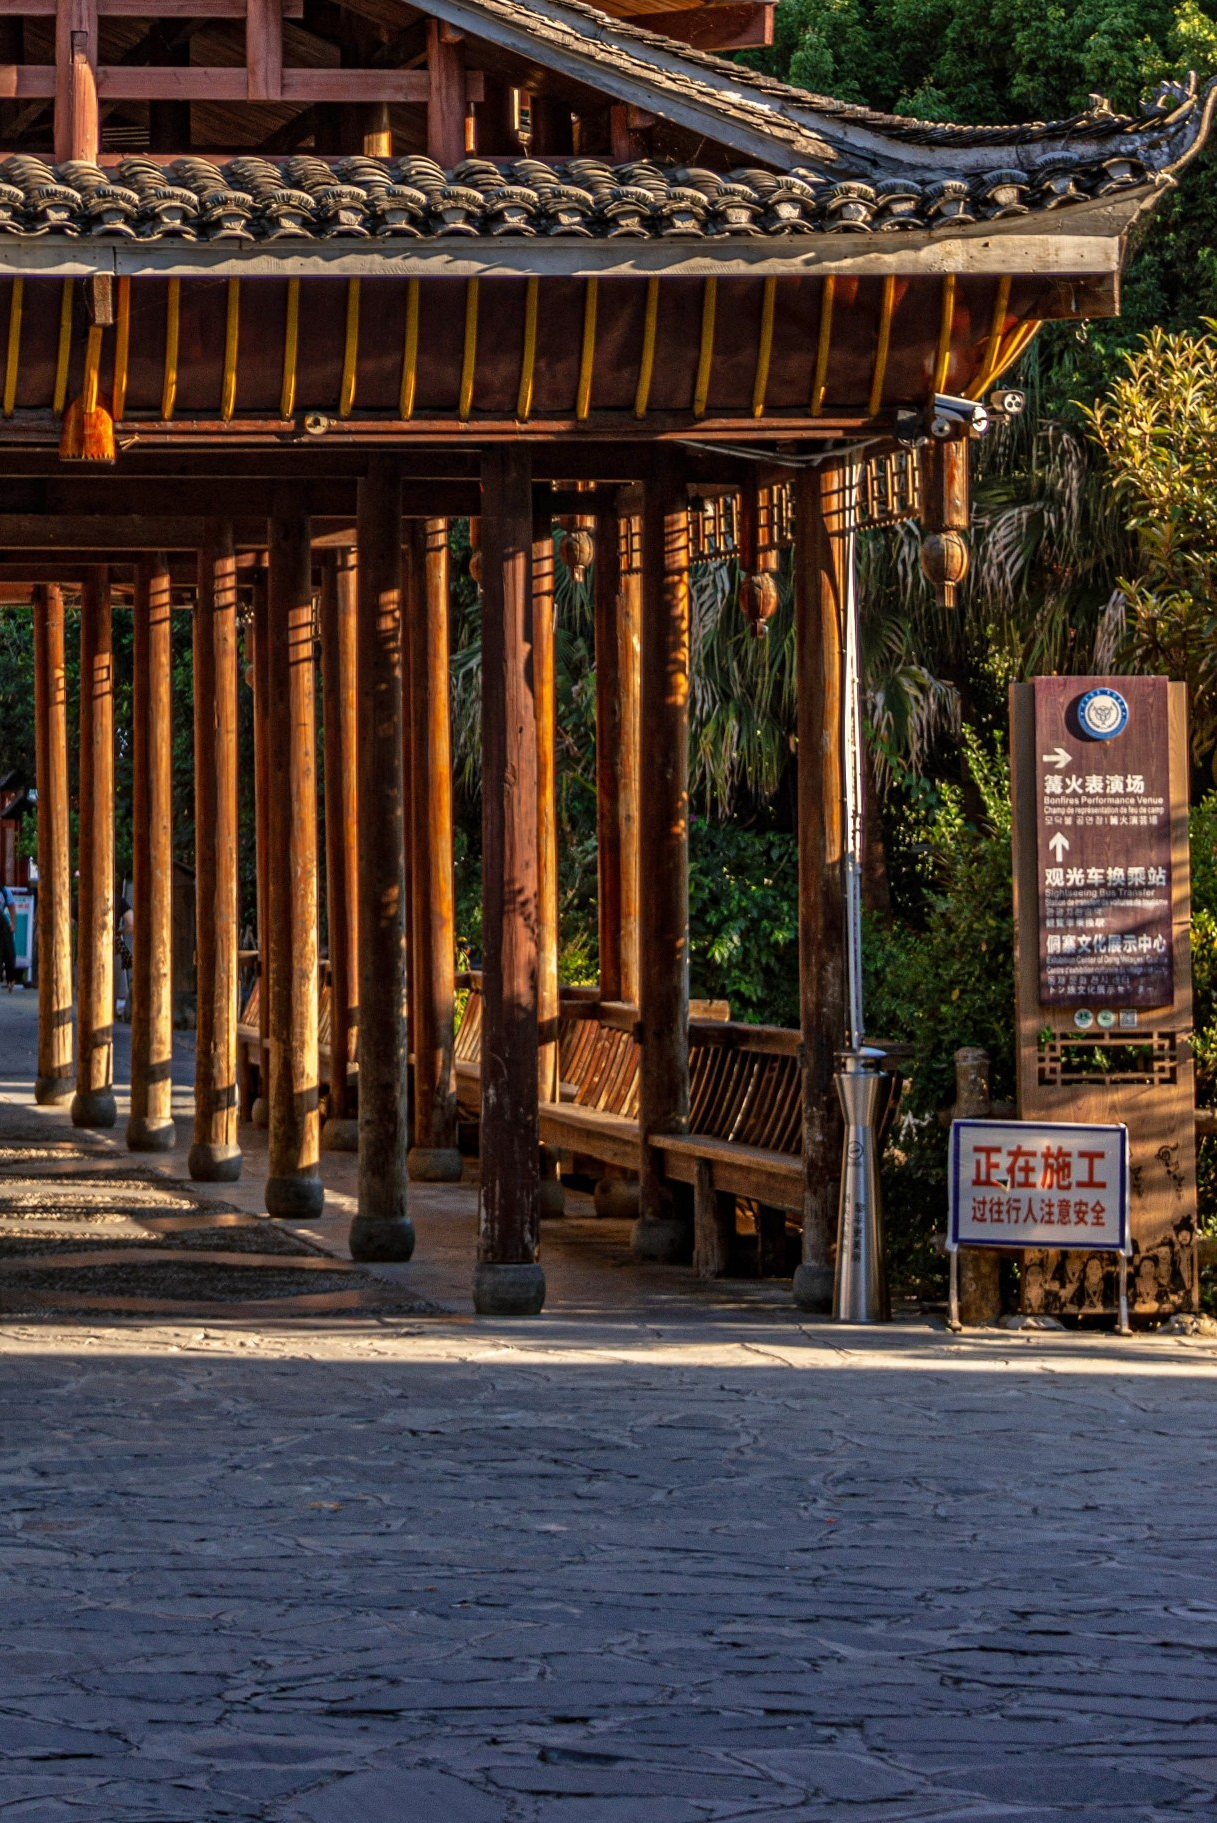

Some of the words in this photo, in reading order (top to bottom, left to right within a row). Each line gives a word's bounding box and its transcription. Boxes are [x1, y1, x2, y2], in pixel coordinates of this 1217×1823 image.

[1044, 774, 1145, 794] 篝火表演场
[1043, 796, 1080, 805] Bonfires
[1081, 796, 1135, 805] Performance
[1137, 796, 1164, 805] Venue
[1045, 867, 1167, 886] 观光车换乘站
[1045, 888, 1098, 898] Sightseeing
[1099, 888, 1117, 897] Bus
[1119, 888, 1155, 897] Transfer
[1046, 934, 1167, 954] 侗寨文化展示中心
[971, 1144, 1108, 1190] 正在施工
[971, 1197, 1106, 1227] 过往行人注意安全
